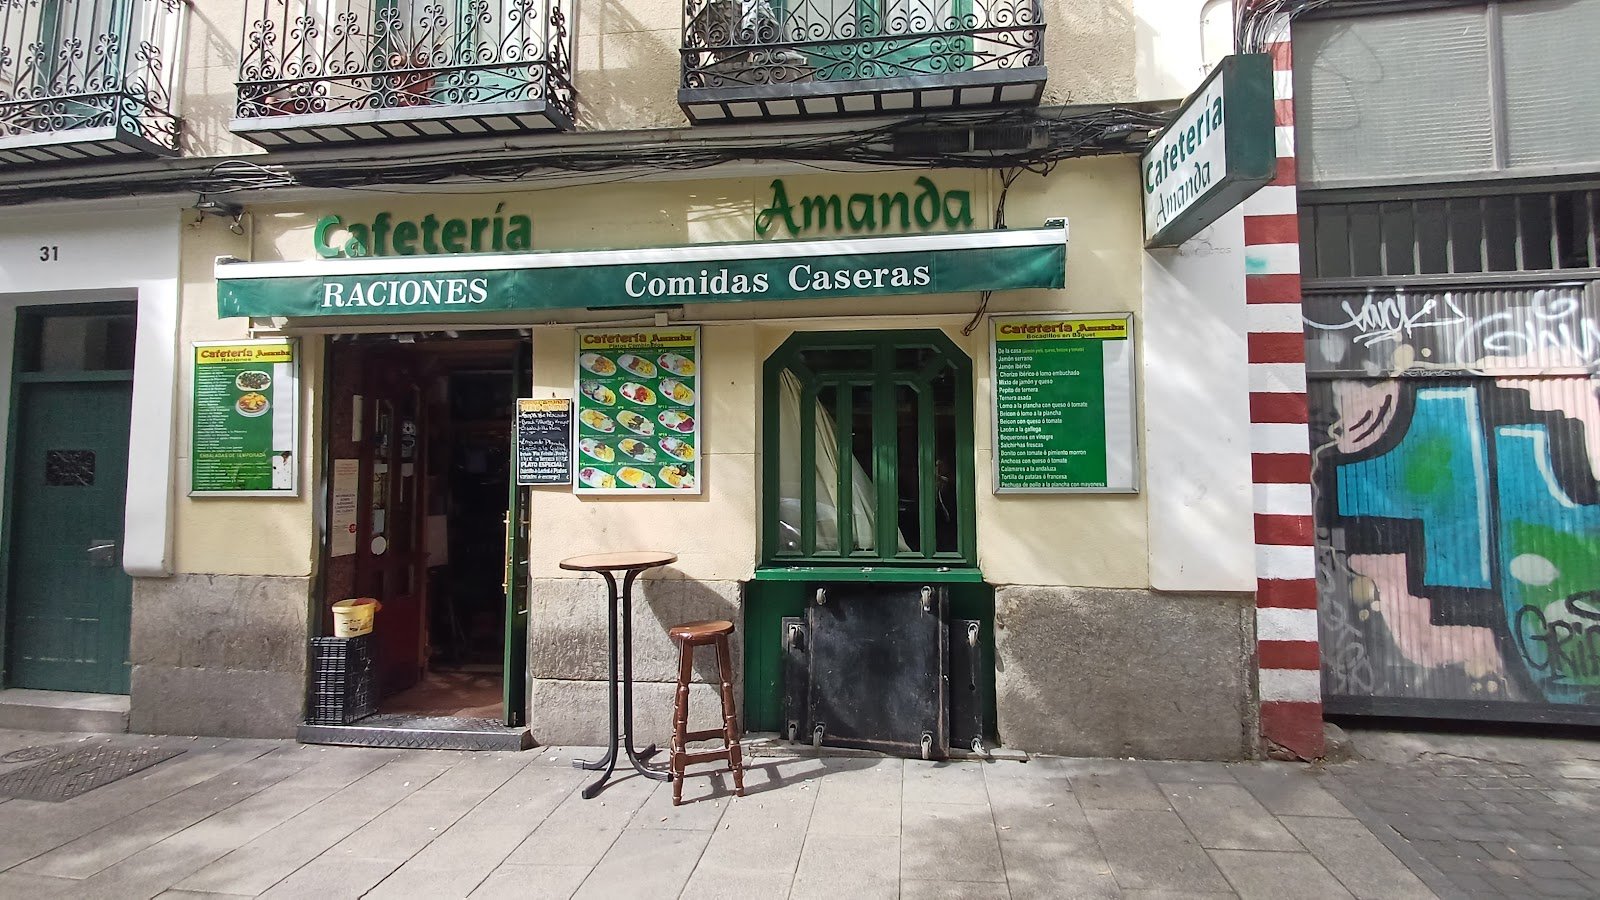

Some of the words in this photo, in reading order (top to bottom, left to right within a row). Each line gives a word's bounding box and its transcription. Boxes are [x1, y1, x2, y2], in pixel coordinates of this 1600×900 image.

[1146, 94, 1222, 194] Cafetería
[1157, 161, 1210, 227] Amanda
[314, 202, 532, 258] Cafetería
[756, 176, 974, 236] Amanda
[40, 246, 58, 261] 31
[321, 278, 488, 308] RACIONES
[625, 269, 769, 298] Comidas
[788, 263, 931, 292] Caseras
[584, 333, 647, 344] Cafetería
[1000, 323, 1072, 334] Cafetería
[201, 349, 253, 358] Cafetería
